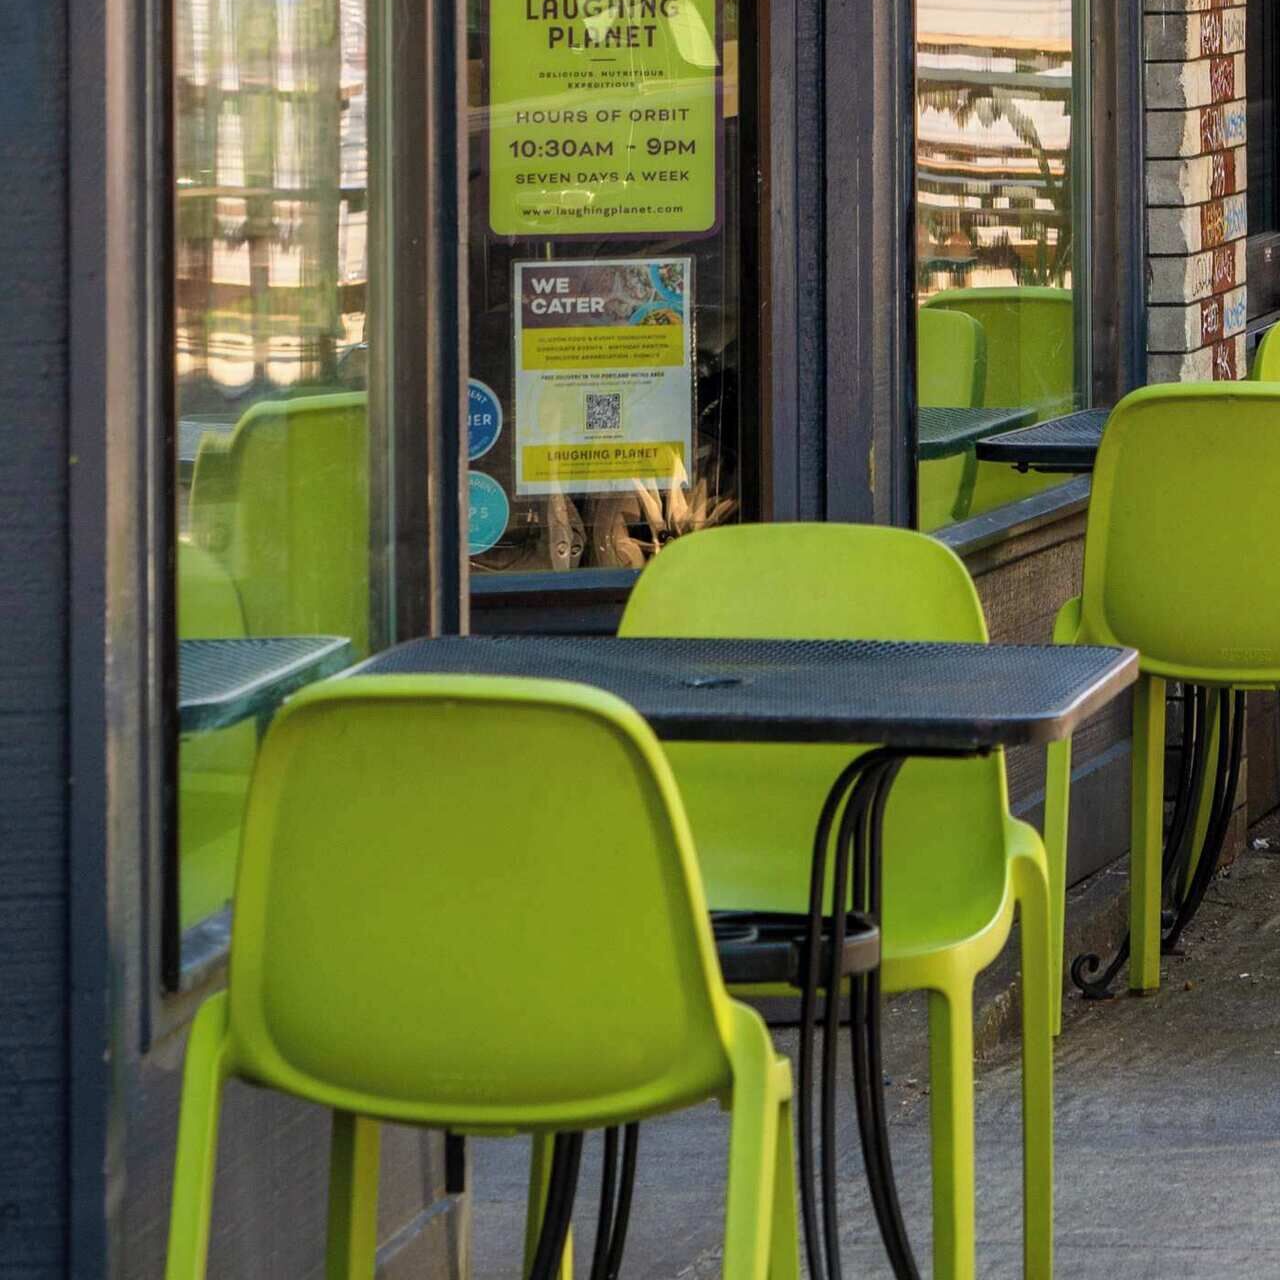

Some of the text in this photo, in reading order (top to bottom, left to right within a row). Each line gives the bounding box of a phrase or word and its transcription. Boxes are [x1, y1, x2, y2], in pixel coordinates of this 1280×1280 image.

[548, 25, 657, 49] PLANET
[516, 108, 690, 124] HOURS OF ORBIT
[509, 139, 614, 159] 10:30AM
[647, 137, 696, 156] 9PM
[515, 170, 690, 185] SEVEN DAYS A WEEK
[521, 204, 684, 218] www.laughingplanet.com
[531, 278, 570, 294] WE
[531, 298, 605, 315] CATER
[547, 448, 658, 461] LAUGHING PLANET
